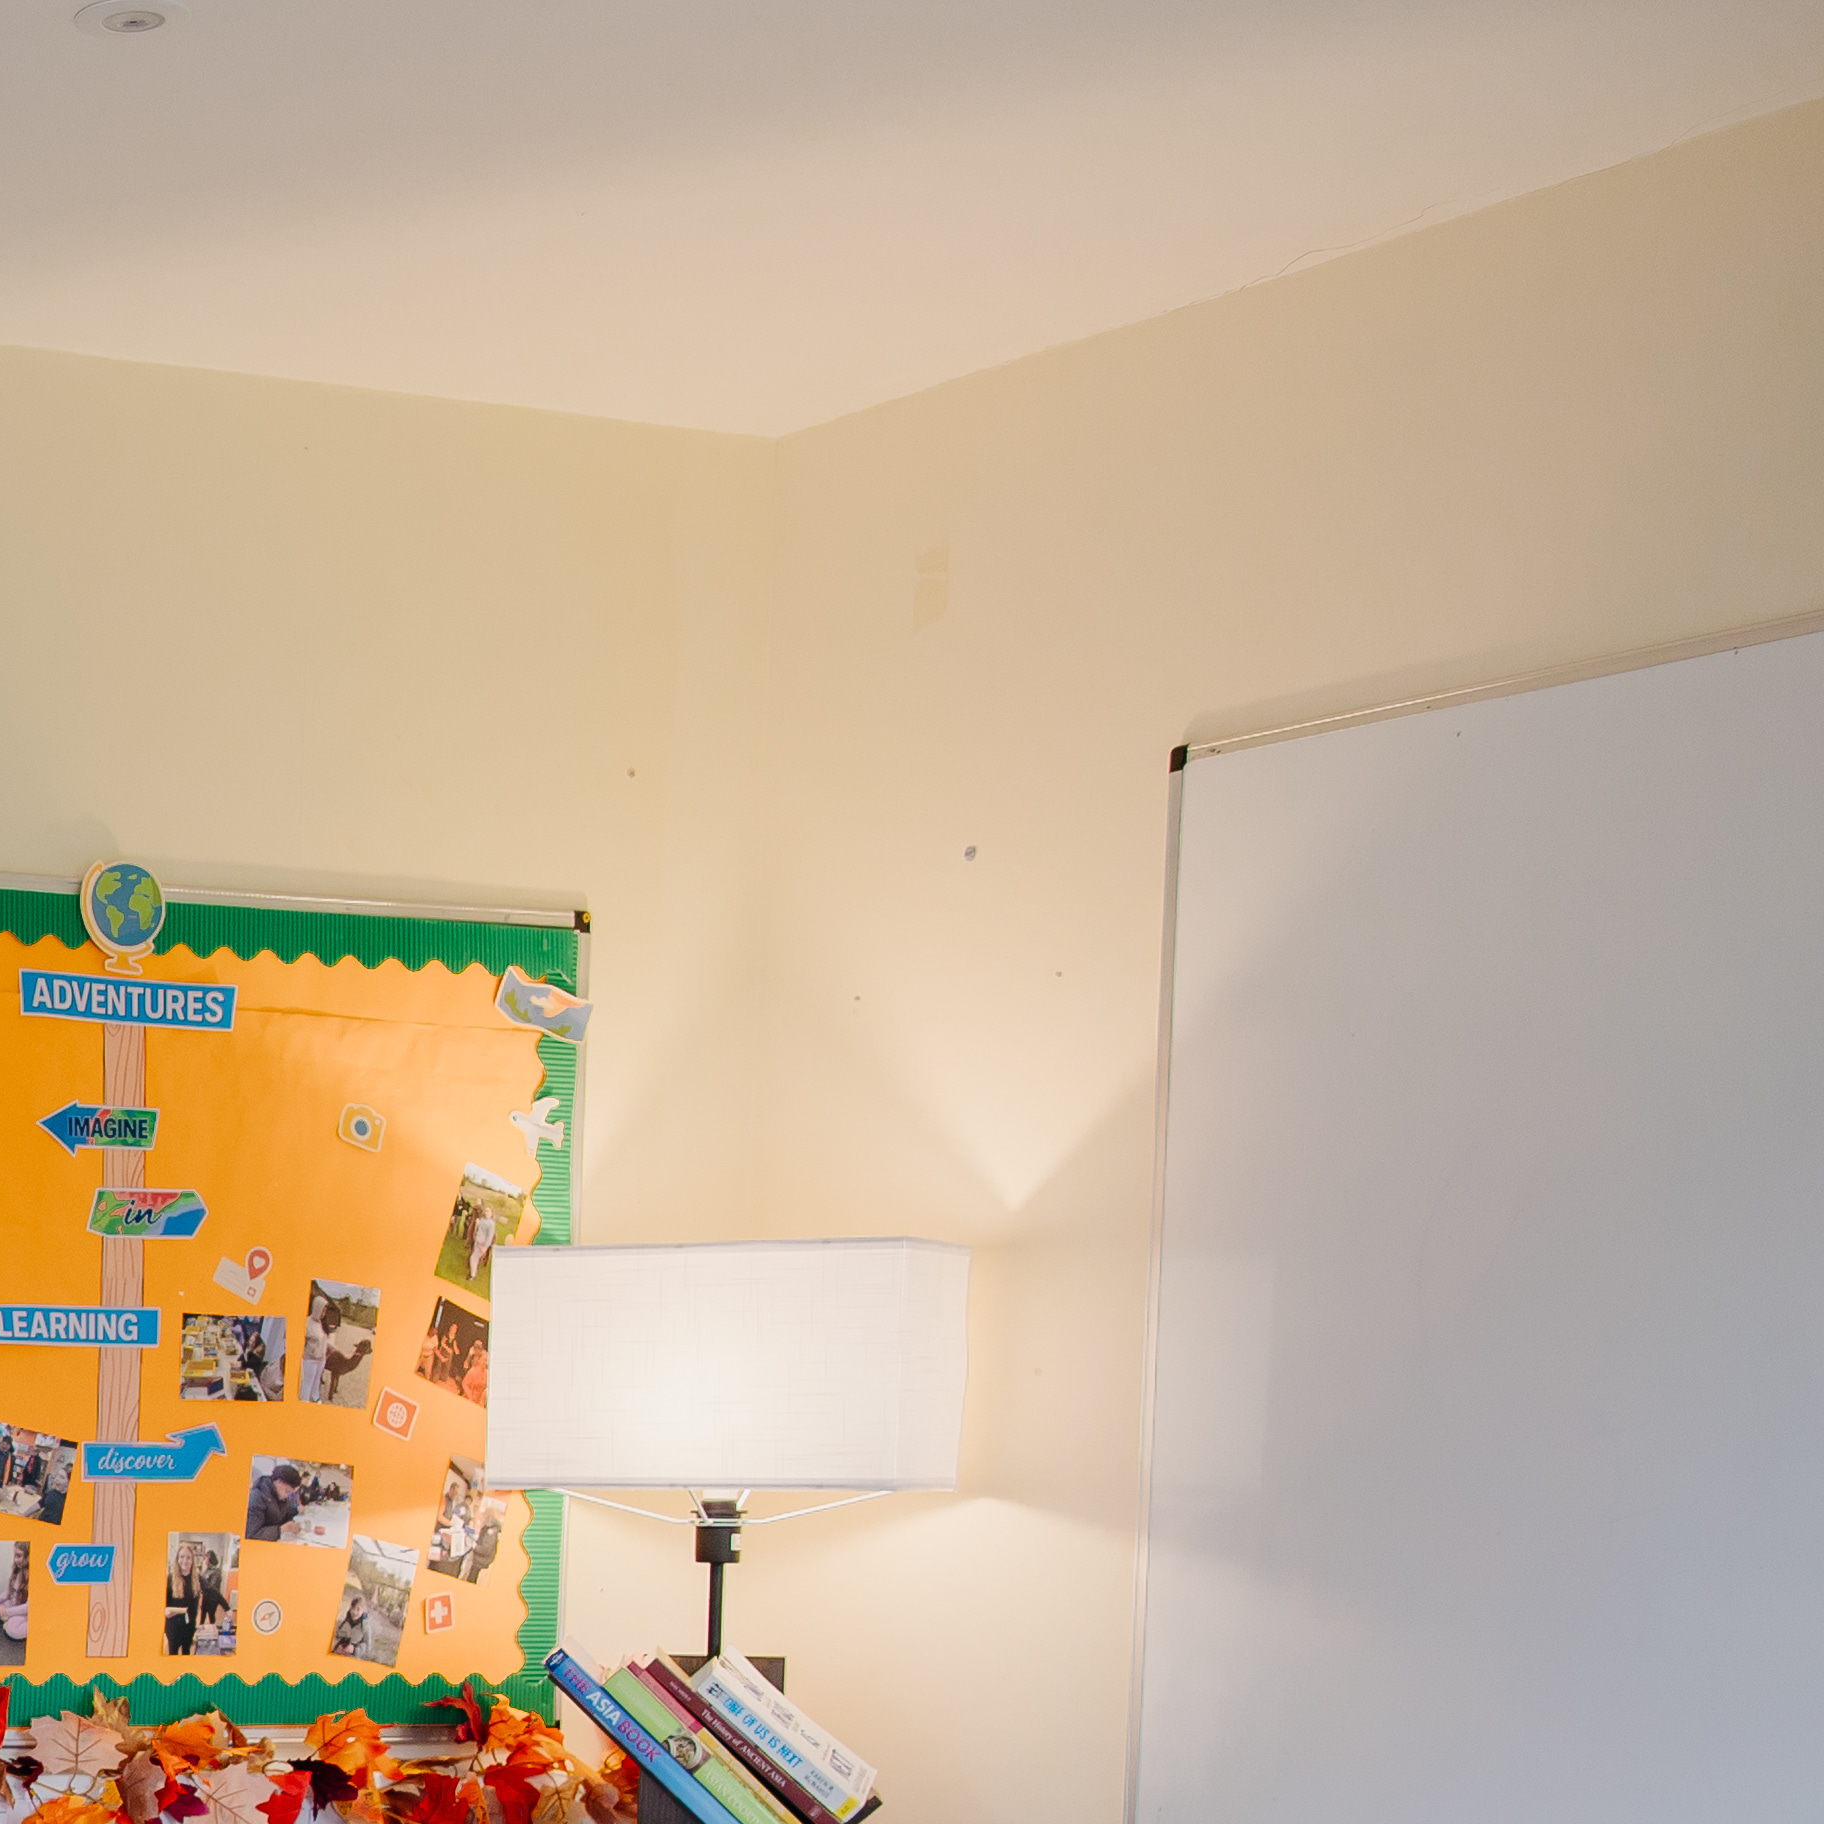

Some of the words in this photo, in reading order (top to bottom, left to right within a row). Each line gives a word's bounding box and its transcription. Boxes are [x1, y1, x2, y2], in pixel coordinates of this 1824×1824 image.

[32, 977, 226, 1024] ADVENTURES
[68, 1116, 149, 1139] IMAGINE
[123, 1199, 163, 1225] in
[98, 1448, 178, 1474] discover
[56, 1551, 109, 1579] grow
[564, 1666, 592, 1695] THE
[586, 1691, 621, 1726] ASIA
[618, 1719, 661, 1763] BOOK
[702, 1709, 714, 1722] The
[711, 1717, 732, 1741] History
[732, 1736, 743, 1749] of
[739, 1745, 772, 1773] ANCIENT
[769, 1769, 786, 1788] ASIA
[723, 1698, 745, 1717] ONE
[743, 1714, 757, 1728] OF
[754, 1724, 770, 1740] US
[768, 1736, 780, 1749] IS
[776, 1743, 803, 1768] NEXT
[702, 1768, 730, 1799] ASIAN
